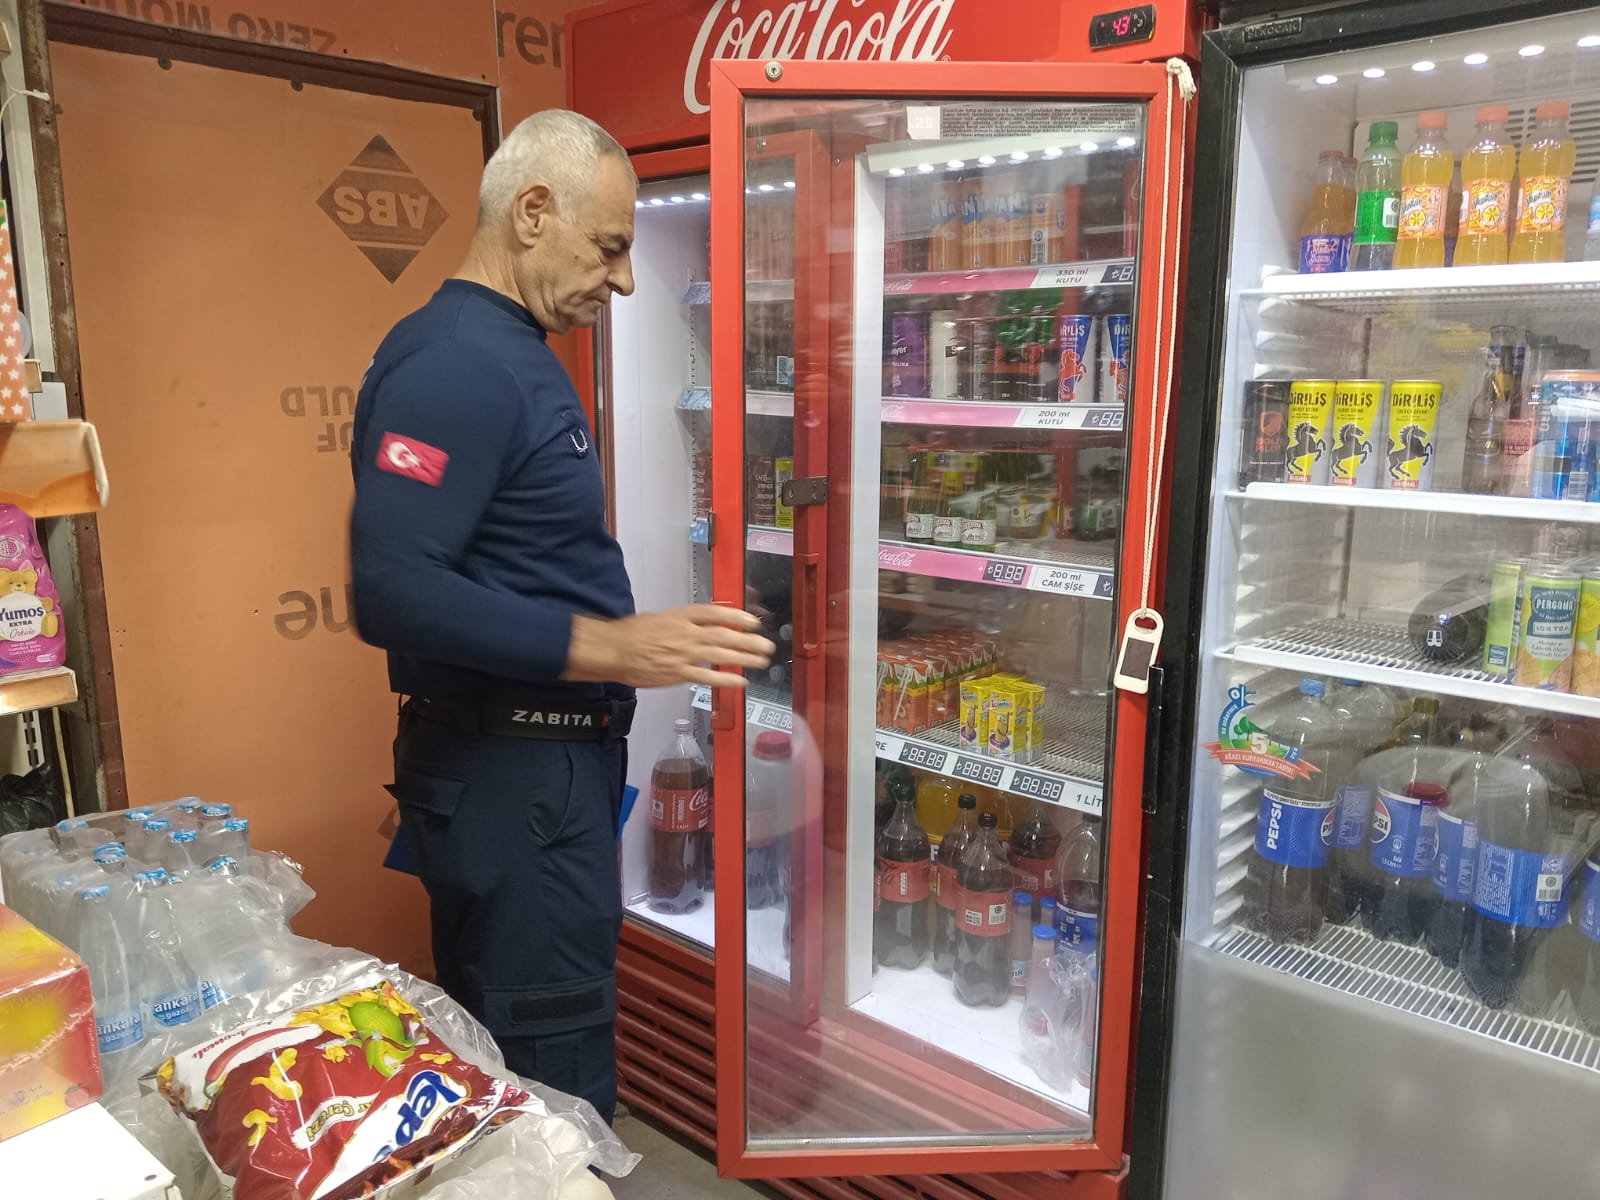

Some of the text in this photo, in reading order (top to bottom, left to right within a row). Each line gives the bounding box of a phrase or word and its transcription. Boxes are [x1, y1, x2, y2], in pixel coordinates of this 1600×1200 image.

[334, 186, 430, 230] ABS
[1055, 276, 1082, 284] KUTU
[1056, 269, 1075, 277] 330
[1076, 268, 1089, 276] ml
[279, 385, 356, 417] ULD
[1058, 410, 1071, 418] ml
[1038, 418, 1065, 426] KUTU
[1050, 570, 1068, 580] 200
[1070, 572, 1082, 582] ml
[1041, 579, 1086, 592] CAM ŞİŞE
[0, 606, 44, 621] Yumos
[9, 620, 33, 628] EXTRA
[512, 709, 592, 726] ZABITA
[1251, 732, 1269, 755] 5
[1266, 802, 1283, 850] PEPSI
[154, 991, 200, 1013] ankara
[306, 1099, 355, 1142] Çerezi
